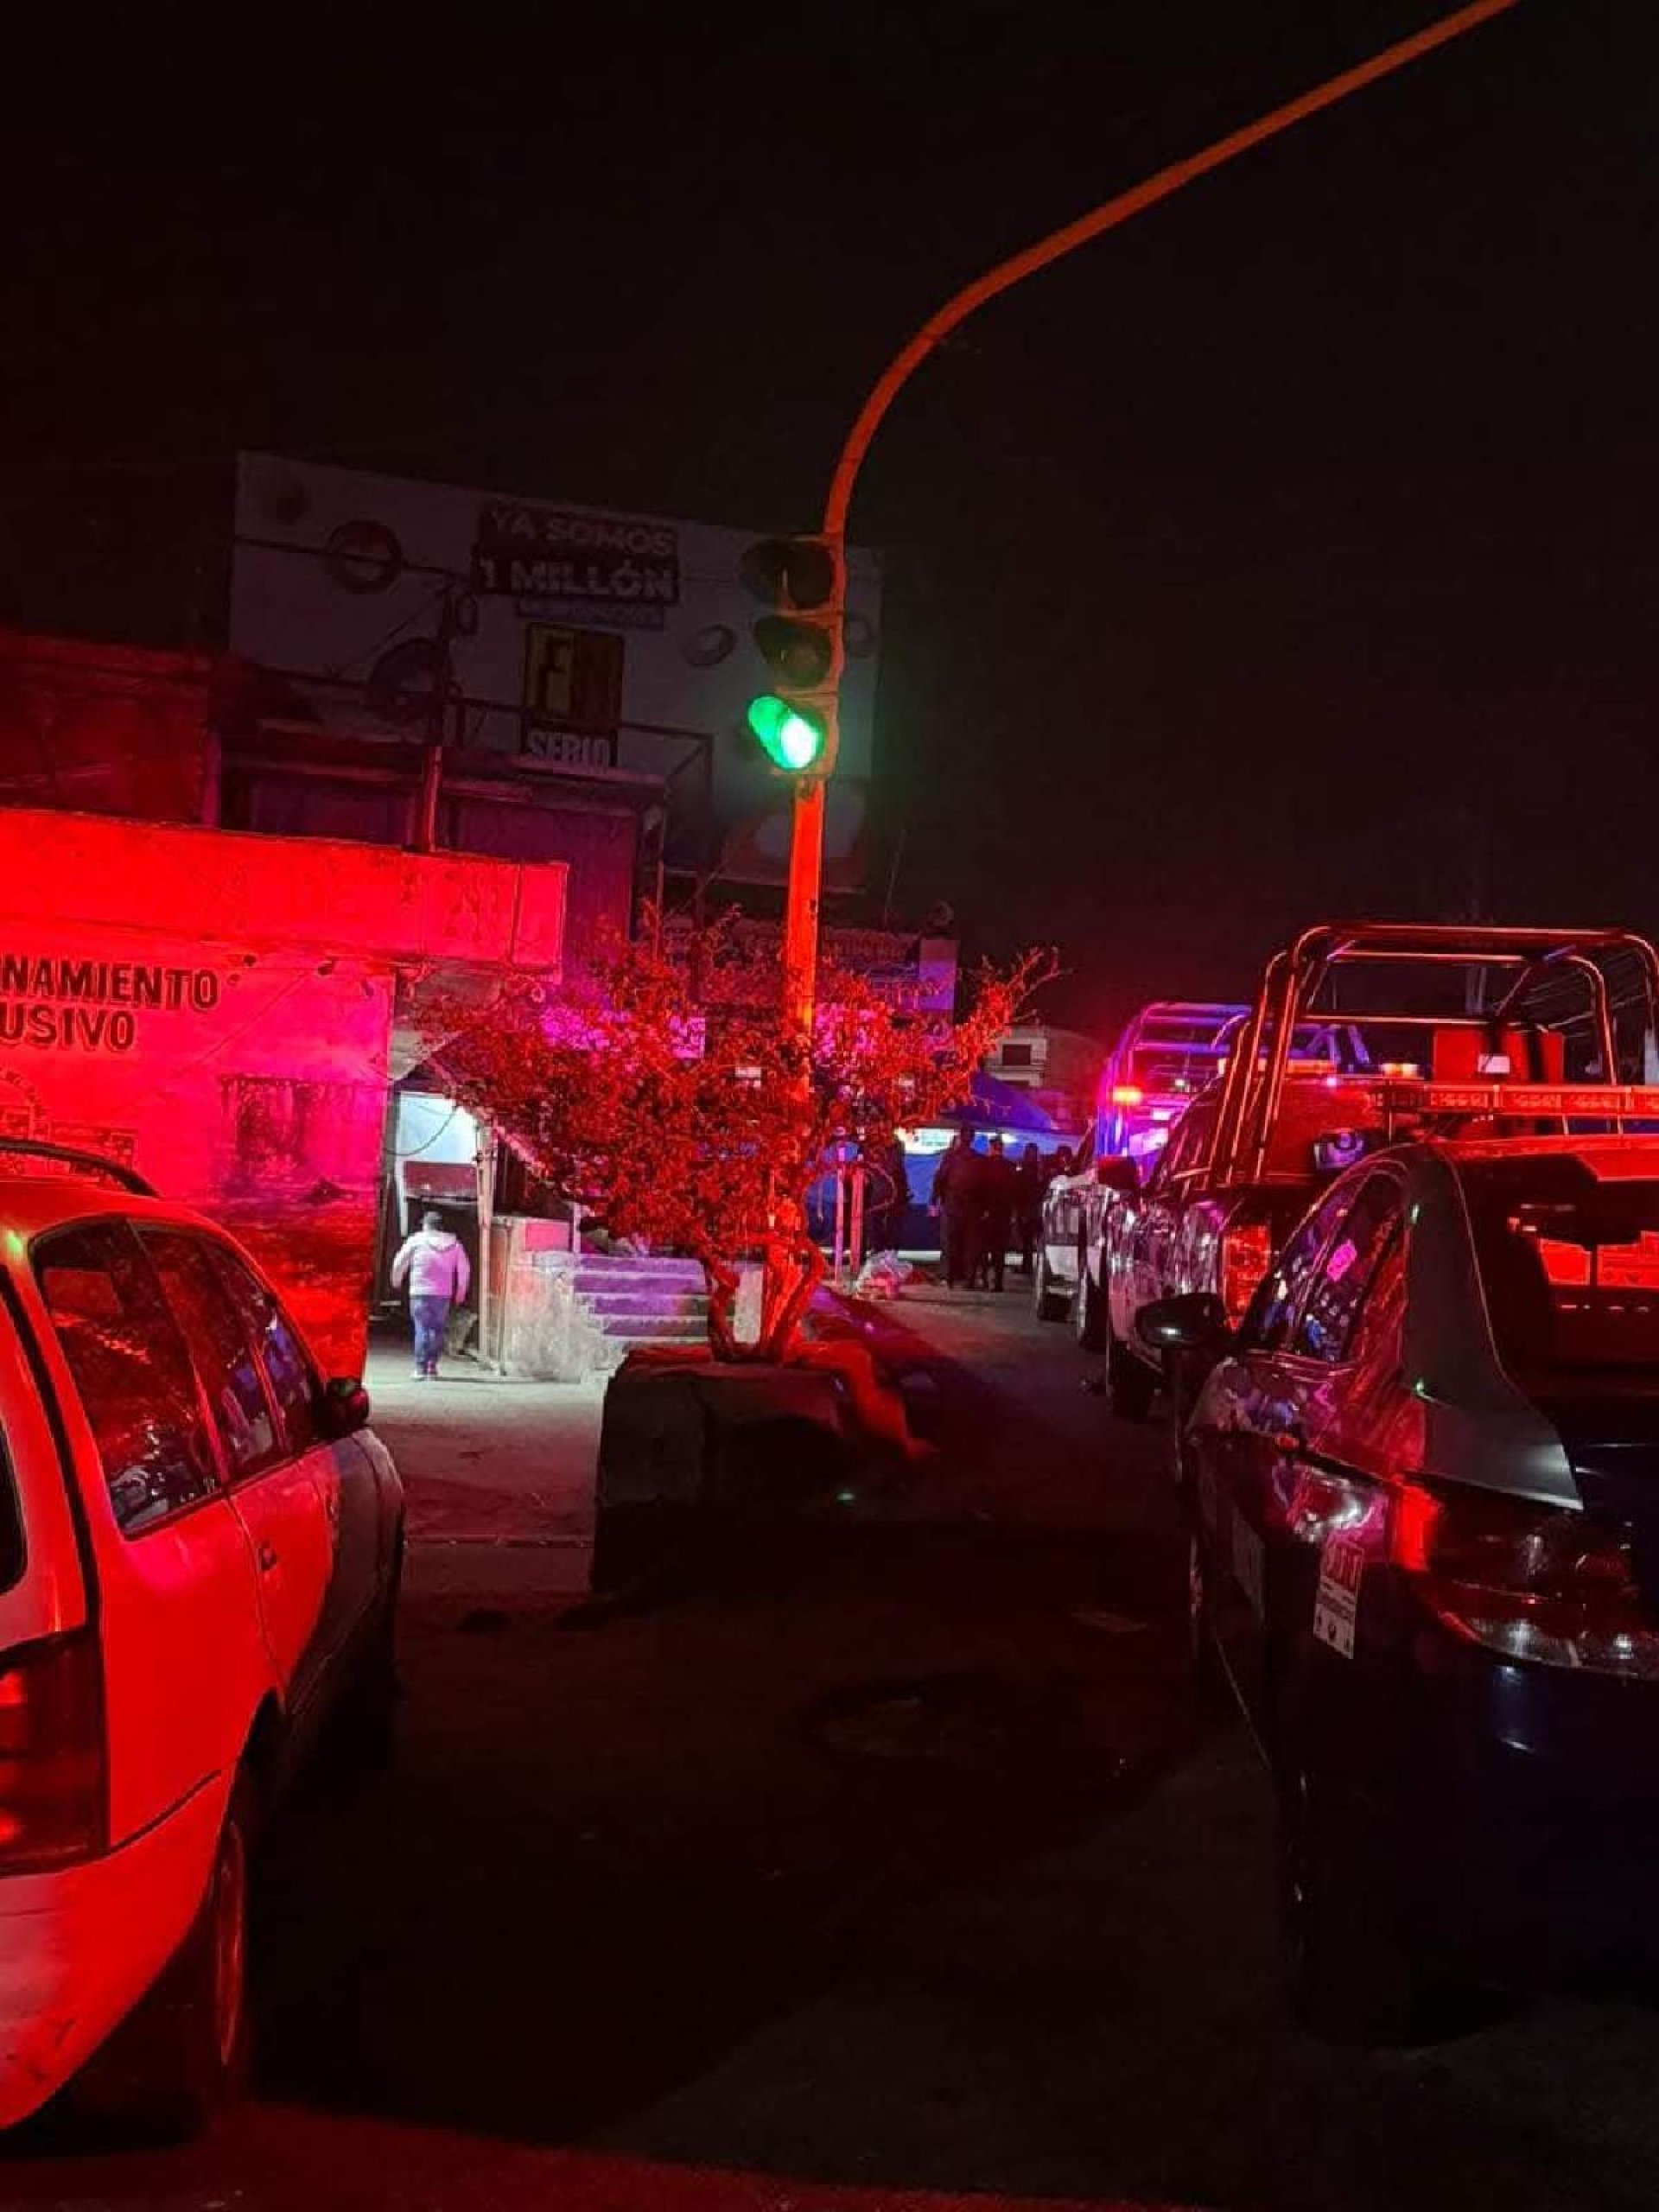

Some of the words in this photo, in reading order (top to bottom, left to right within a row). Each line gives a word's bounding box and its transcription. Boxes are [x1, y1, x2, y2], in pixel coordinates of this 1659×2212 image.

[486, 508, 540, 542] YA
[543, 517, 677, 555] SOMOS
[478, 556, 498, 589] 1
[509, 559, 677, 599] MILLÓN
